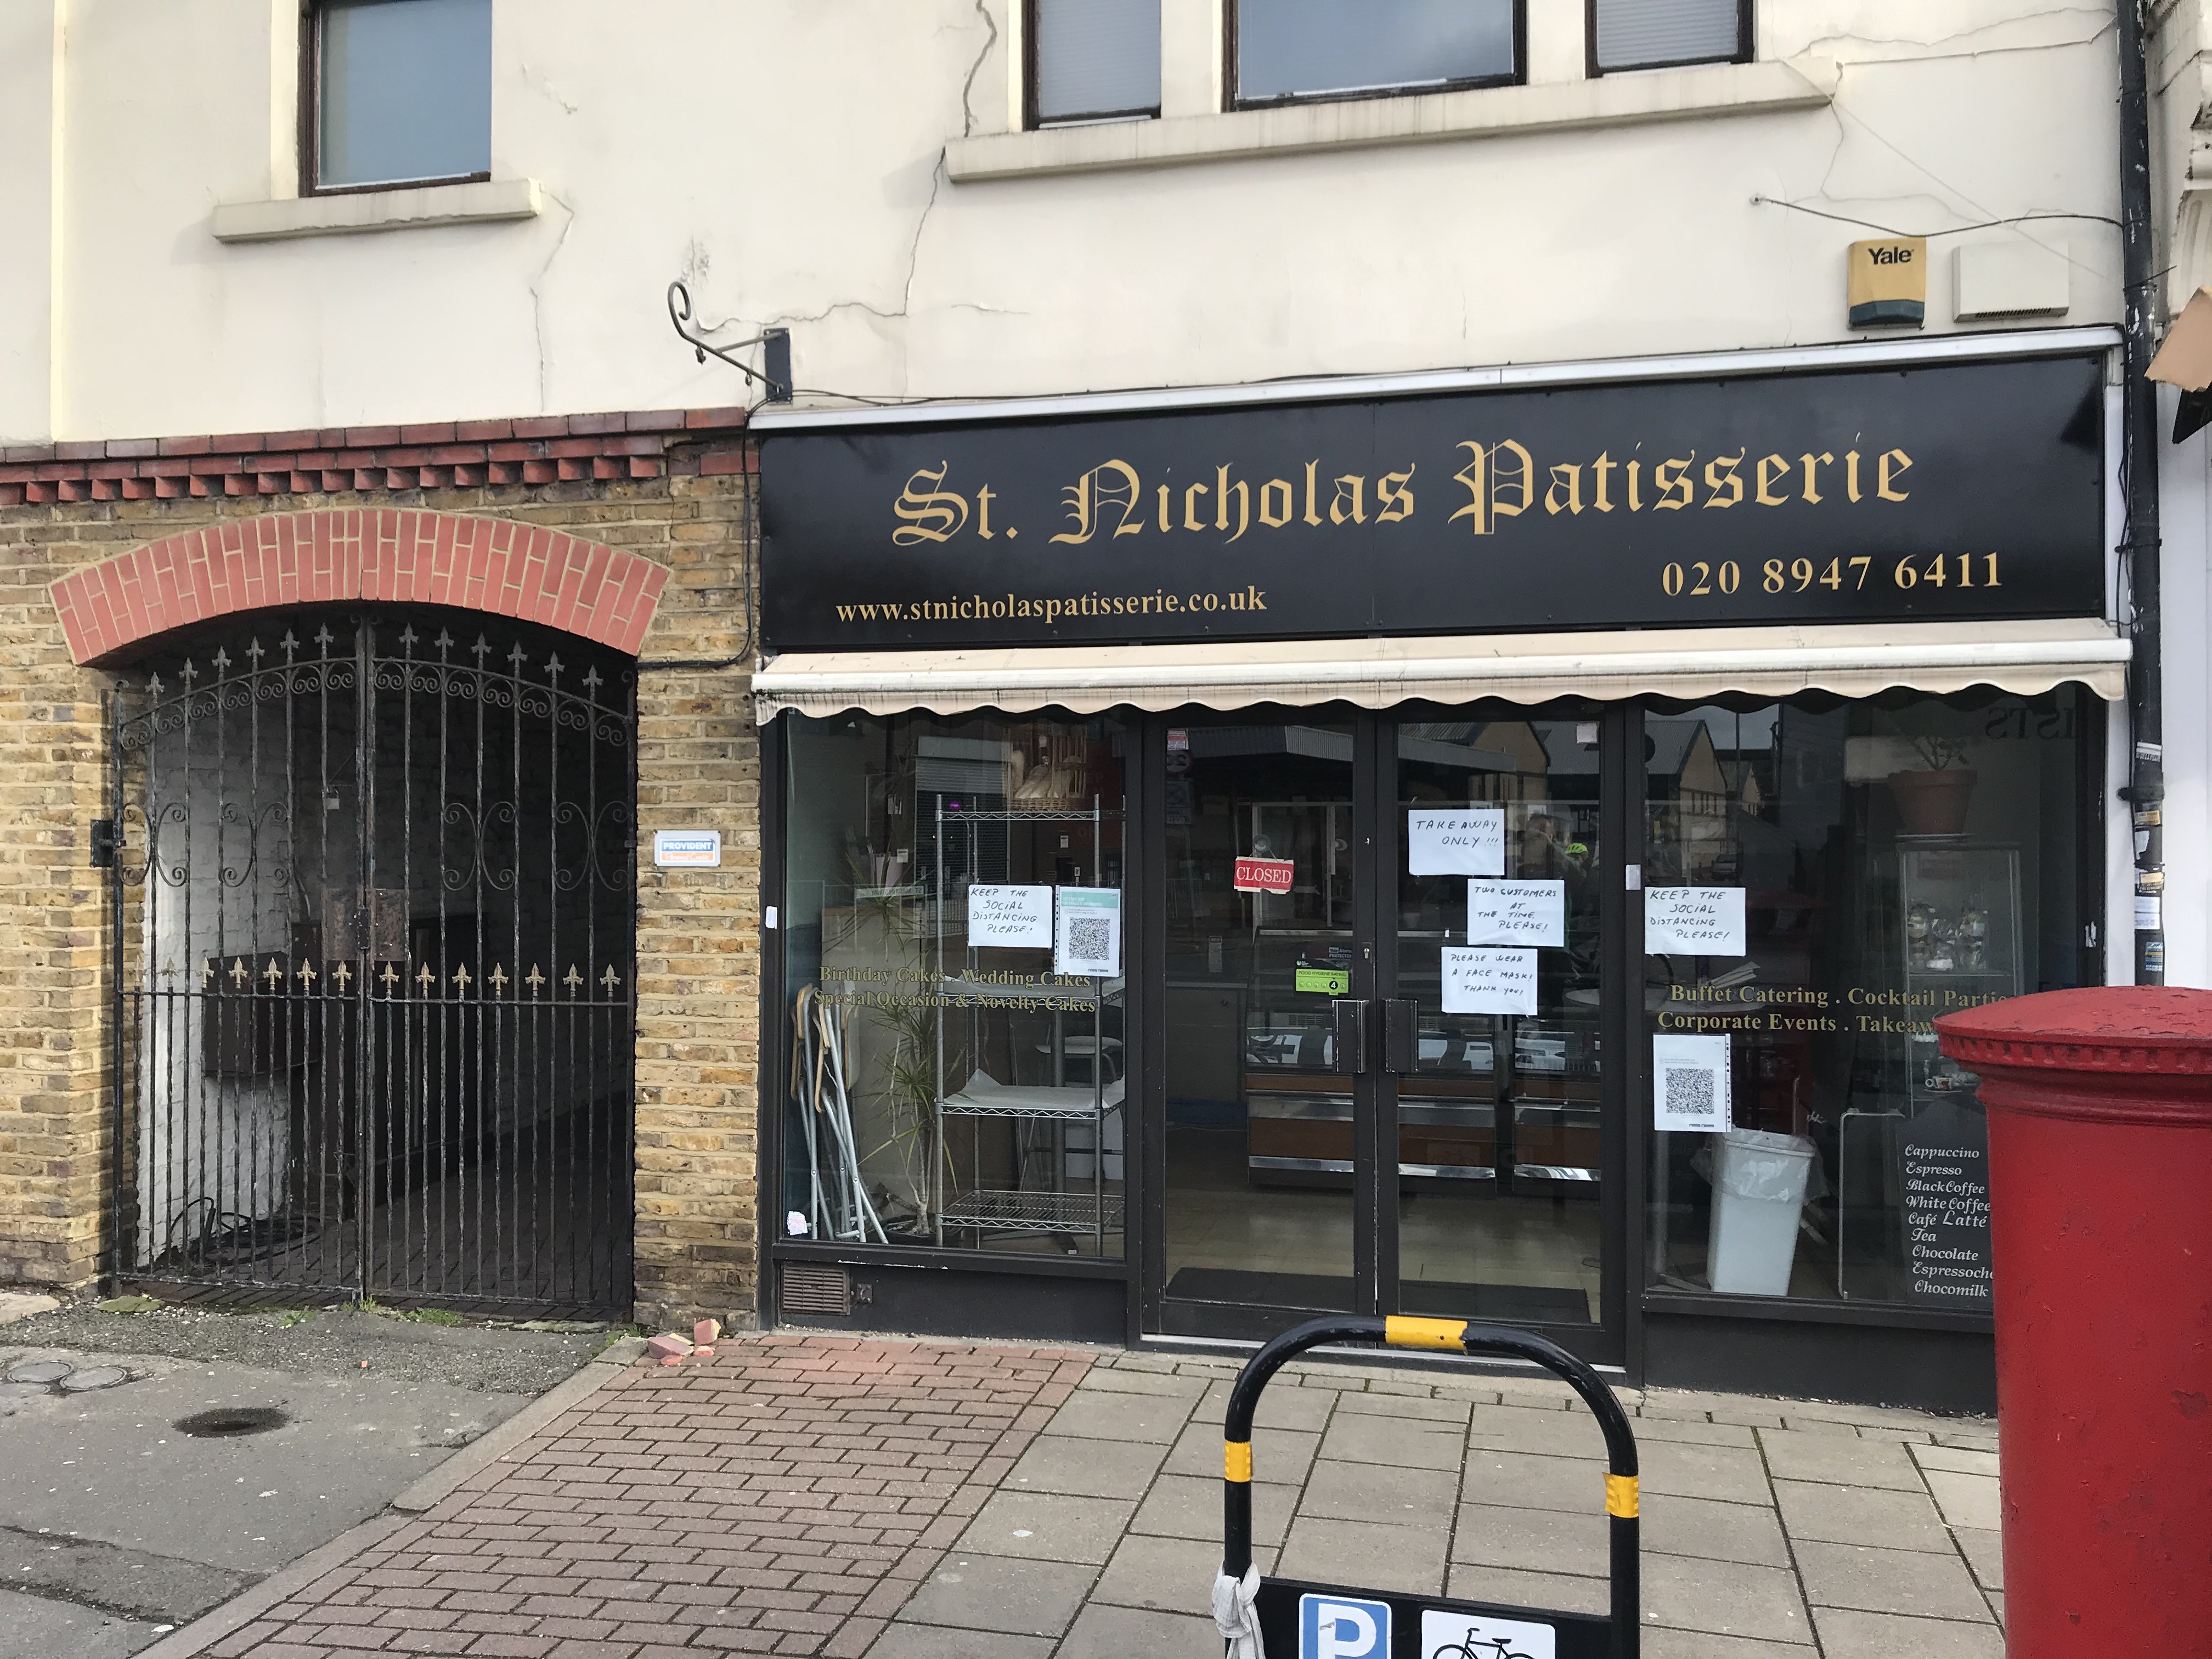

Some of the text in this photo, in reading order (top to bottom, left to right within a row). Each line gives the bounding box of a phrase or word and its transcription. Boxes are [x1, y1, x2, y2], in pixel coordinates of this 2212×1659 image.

[1868, 246, 1912, 265] Yale
[891, 431, 1913, 546] St. Nicholas Patisserie
[1662, 551, 2002, 596] 020 8947 6411
[836, 585, 1267, 624] www.stnicholaspatisserie.co.uk
[1417, 820, 1497, 832] TAKE AWAY
[663, 842, 712, 850] PROVIDENT
[1442, 836, 1480, 848] ONLY
[1235, 866, 1291, 884] CLOSED
[970, 888, 999, 897] KEEP
[1500, 888, 1557, 898] CUSTOMERS
[1650, 889, 1726, 900] KEEP THE
[1498, 920, 1549, 933] PLEASE!
[1675, 929, 1730, 942] PLEASE!
[820, 966, 1091, 989] Birthday Cakes Wedding Cakes
[1466, 969, 1493, 977] FACE
[1499, 971, 1533, 982] MASK!
[1503, 987, 1524, 996] YOU!
[1671, 984, 1732, 1001] Buffet
[1739, 985, 1829, 1008] Catering
[1848, 988, 1936, 1006] Cocktail
[814, 990, 1096, 1014] Special Occasion & Novelty Cakes
[1658, 1011, 1762, 1033] Corporate
[1768, 1013, 1837, 1031] Events
[1905, 1144, 1980, 1159] Cappuccino
[1906, 1161, 1962, 1177] Espresso
[1906, 1195, 1990, 1214] White Coffee
[1908, 1210, 1988, 1228] Café Latté
[1911, 1228, 1937, 1243] Tea
[1912, 1244, 1979, 1261] Chocolate
[1915, 1279, 1989, 1297] Chocomilk
